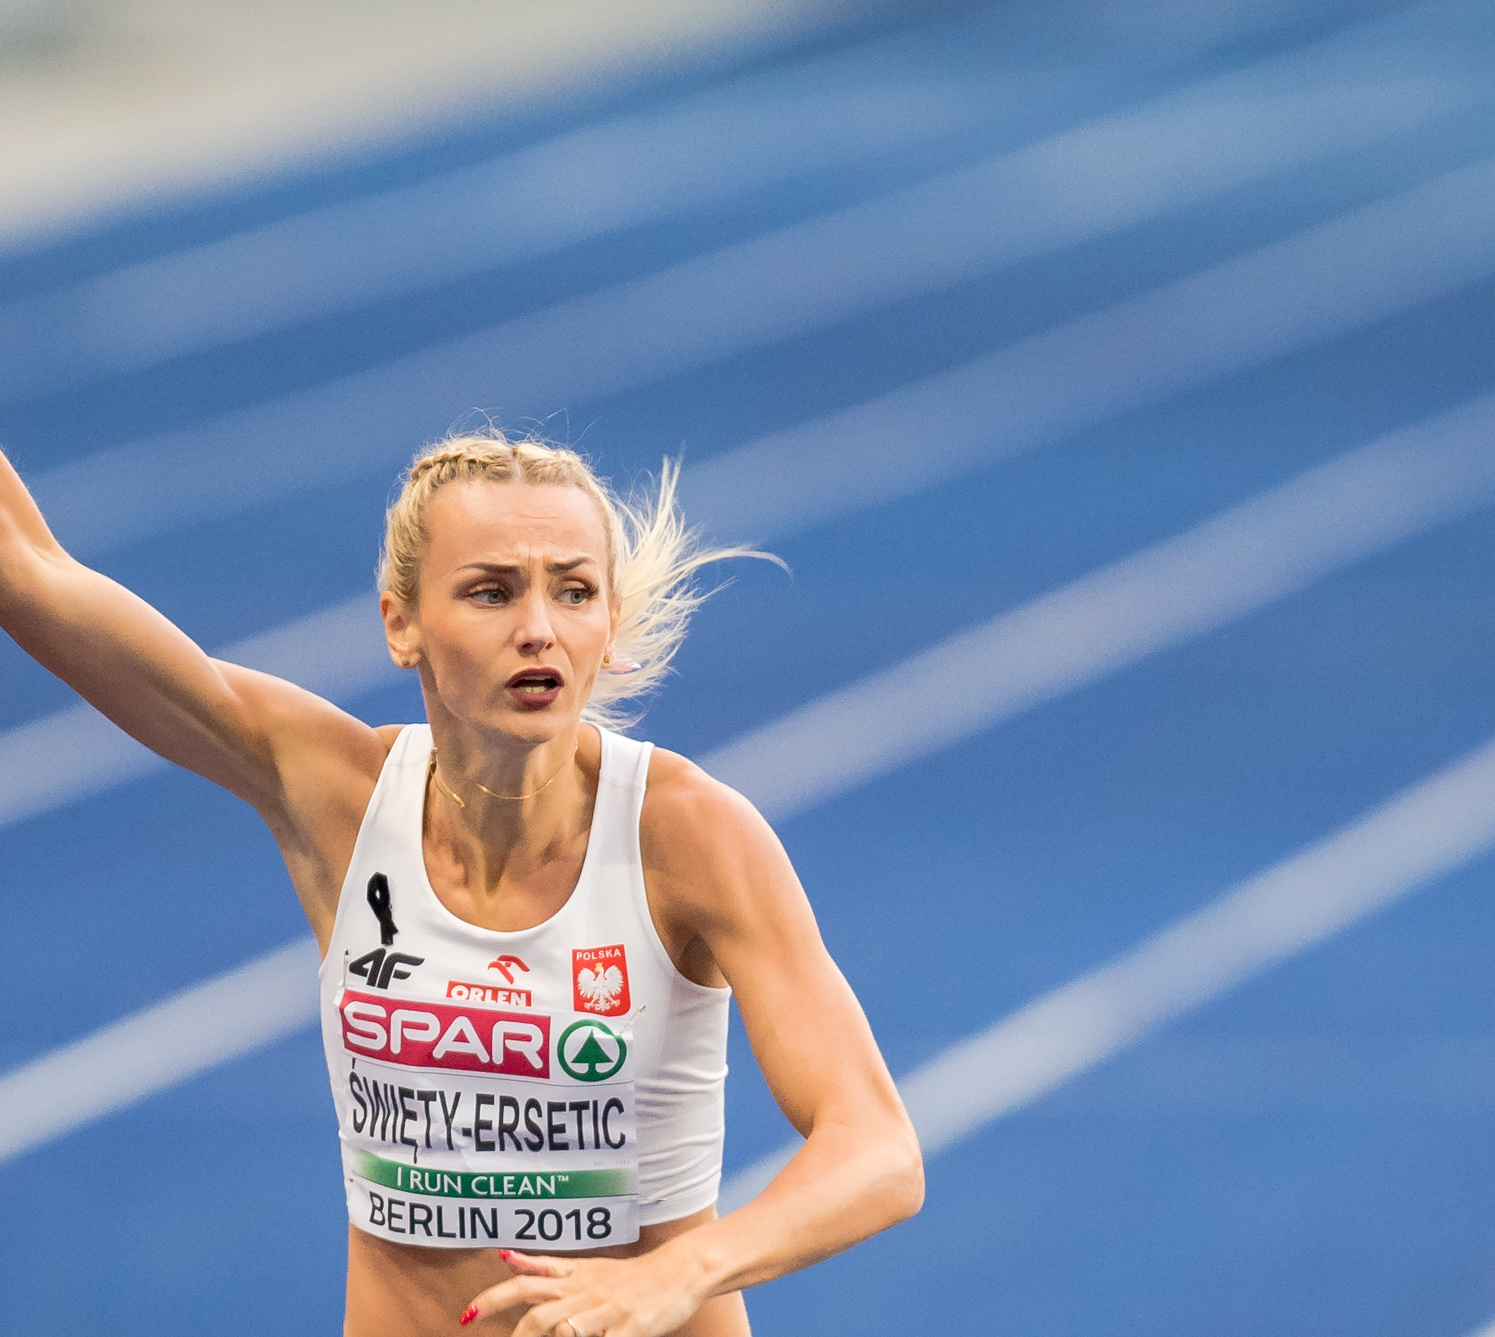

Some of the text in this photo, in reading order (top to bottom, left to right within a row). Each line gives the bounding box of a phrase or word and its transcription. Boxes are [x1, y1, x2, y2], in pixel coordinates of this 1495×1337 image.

[348, 947, 426, 990] 4F
[575, 948, 622, 961] POLSKA
[450, 985, 527, 1007] ORLEN
[344, 1000, 544, 1070] SPAR
[348, 1057, 627, 1165] ŚWIĘTY-ERSETIC
[396, 1166, 402, 1187] I
[409, 1169, 463, 1194] RUN
[368, 1190, 613, 1241] BERLIN 2018
